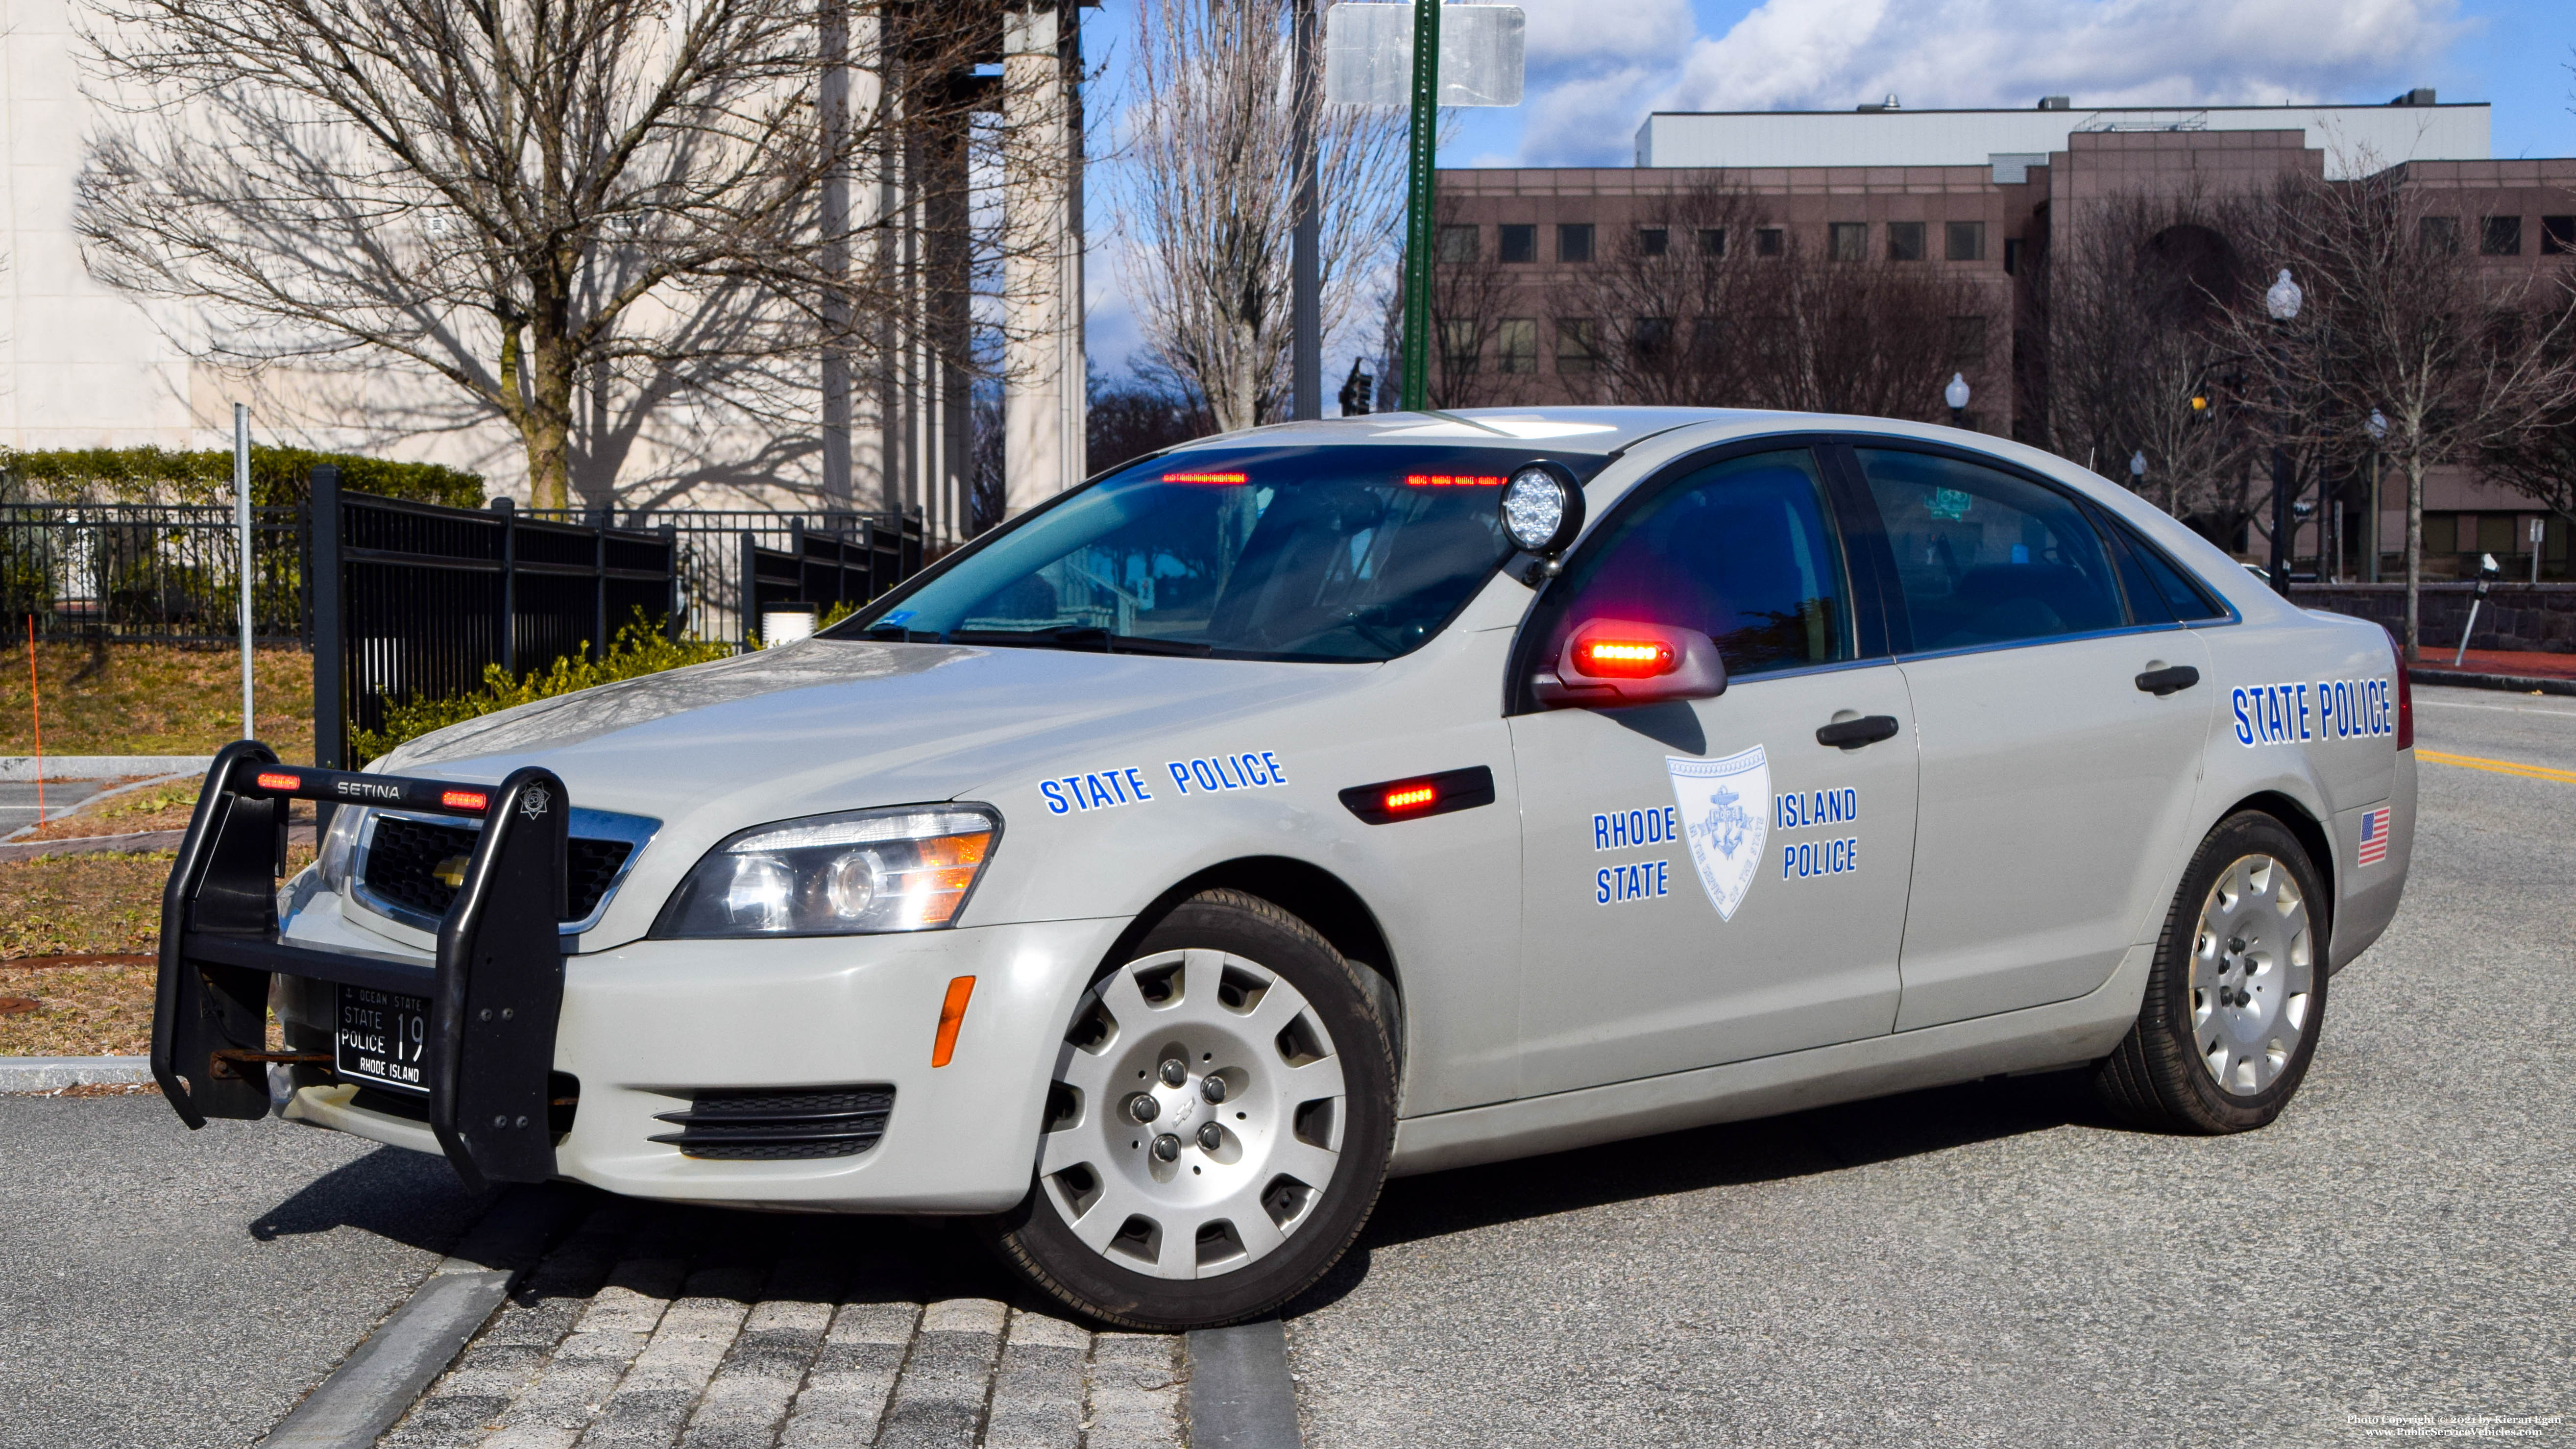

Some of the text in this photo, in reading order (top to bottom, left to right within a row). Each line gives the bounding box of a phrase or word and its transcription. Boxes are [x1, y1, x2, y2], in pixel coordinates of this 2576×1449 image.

[2231, 678, 2392, 748] STATE POLICE
[338, 782, 400, 799] SETINA
[1038, 750, 1288, 816] STATE POLICE
[1592, 786, 1857, 852] RHODE ISLAND
[1714, 810, 1737, 820] HOPE
[1596, 836, 1857, 906] STATE POLICE
[360, 989, 422, 1011] OCEAN STATE
[345, 1006, 383, 1030] STATE
[342, 1029, 385, 1054] POLICE
[360, 1056, 419, 1083] RHODE ISLAND
